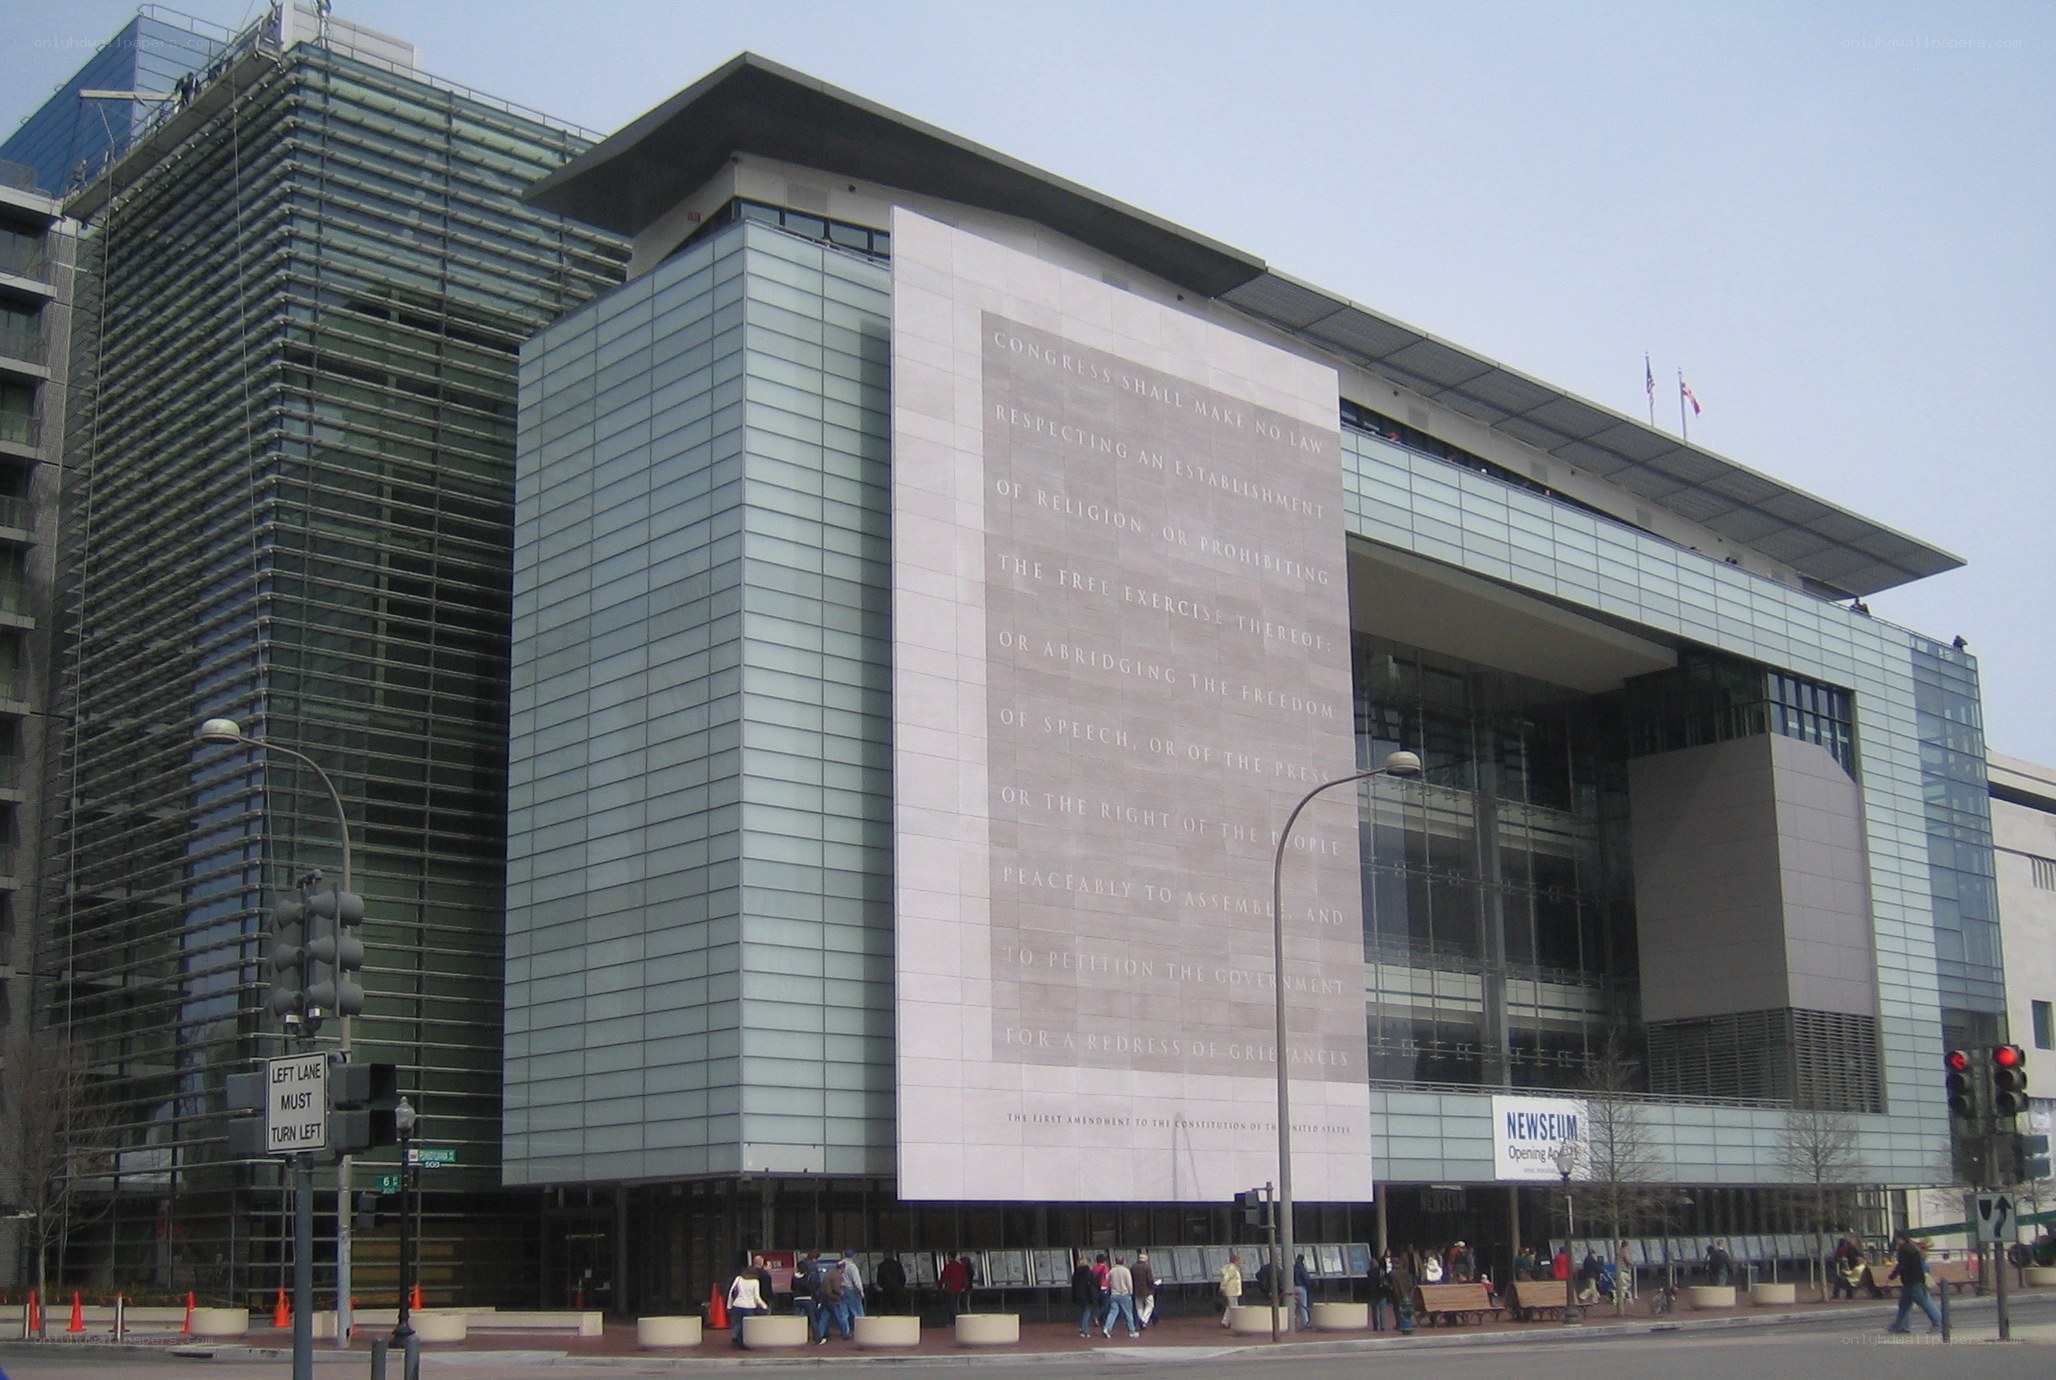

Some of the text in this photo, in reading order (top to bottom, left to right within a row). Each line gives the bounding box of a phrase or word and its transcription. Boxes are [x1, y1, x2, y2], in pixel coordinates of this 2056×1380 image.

[994, 331, 1324, 455] CONGRESS SHALL MAKE NO LAW
[995, 404, 1325, 520] RESPECTING AN ESTABLISHMENT
[996, 479, 1023, 499] OF
[1162, 526, 1188, 547] OR
[1200, 535, 1329, 587] PROHIBITING
[998, 553, 1043, 580] THE
[1058, 569, 1110, 596] FREE
[1125, 586, 1223, 626] EXERCISE
[998, 630, 1334, 720] OR ABRIDGING THE FREEDOM
[1000, 708, 1028, 728] OF
[1149, 736, 1175, 757] OR
[1187, 744, 1213, 764] OF
[1224, 751, 1262, 773] THE
[1001, 786, 1030, 807] OR
[1043, 792, 1086, 816] THE
[1100, 802, 1170, 829] RIGHT
[1183, 816, 1206, 834] OF
[1219, 822, 1258, 843] THE
[1003, 866, 1131, 897] PEACEABLY
[1145, 885, 1173, 903] TO
[1306, 906, 1344, 925] AND
[1004, 947, 1344, 995] TO PETITION THE GOVERNMENT
[272, 1063, 321, 1084] LEFT LANE
[1005, 1028, 1349, 1067] FOR A REDRESS OF GRIEANCES
[281, 1092, 312, 1111] MUST
[1007, 1113, 1027, 1122] THE
[1033, 1114, 1062, 1124] FIRST
[1067, 1116, 1130, 1126] AMENDMENT
[1135, 1118, 1148, 1127] TO
[1152, 1119, 1170, 1128] THE
[1174, 1120, 1246, 1130] CONSTITUTION
[1250, 1122, 1261, 1131] OF
[1266, 1124, 1278, 1132] TH
[1321, 1126, 1351, 1135] STATES
[1507, 1112, 1578, 1142] NEWSEUM
[271, 1123, 321, 1143] TURN LEFT
[1508, 1145, 1546, 1163] Opening
